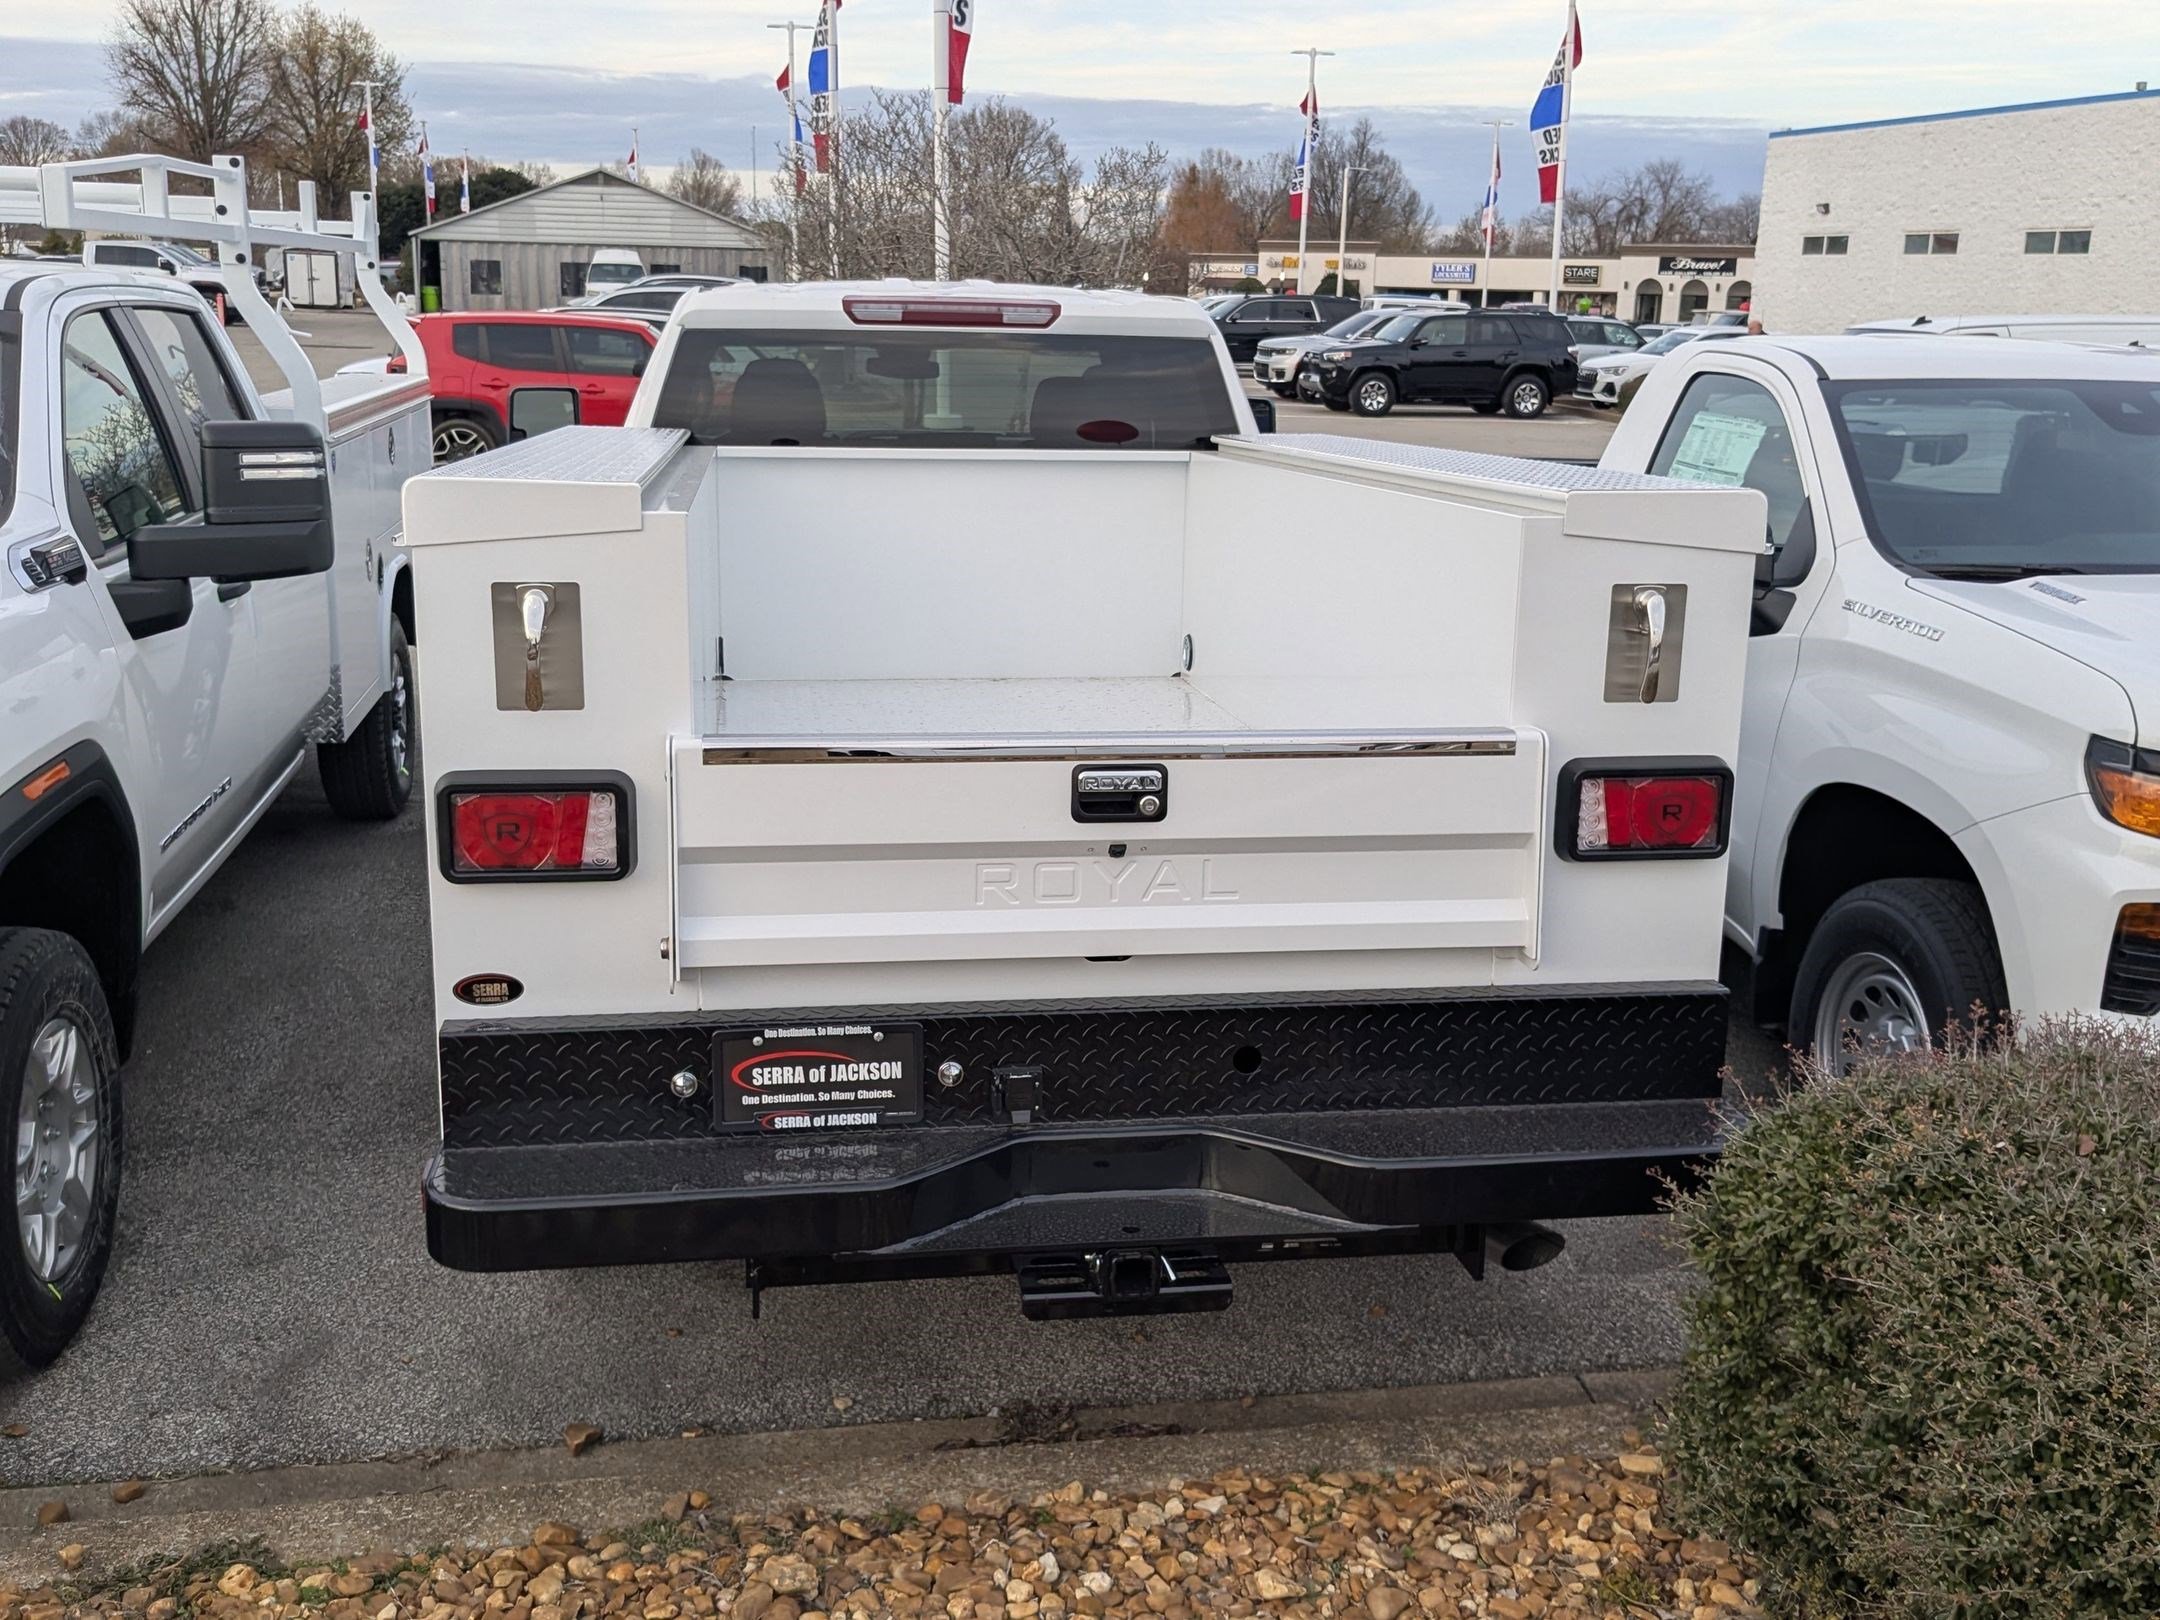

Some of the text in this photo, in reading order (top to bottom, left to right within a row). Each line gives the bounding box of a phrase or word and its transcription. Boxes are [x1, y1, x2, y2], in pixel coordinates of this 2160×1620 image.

[1434, 263, 1471, 272] TYLER'S
[1670, 257, 1726, 270] Bravo!
[1565, 267, 1598, 278] STARE
[1842, 599, 1945, 642] SILVERADO
[1083, 777, 1157, 791] ROYAL
[1662, 804, 1682, 821] R
[496, 822, 521, 842] R
[975, 859, 1240, 905] ROYAL
[472, 983, 509, 997] SERRA
[764, 1025, 873, 1038] One Destination. So Many Choices.
[752, 1061, 902, 1086] SERRA of JACKSON
[742, 1089, 896, 1105] One Destination. So Many Choices.
[774, 1112, 877, 1129] SERRA of JACKSON
